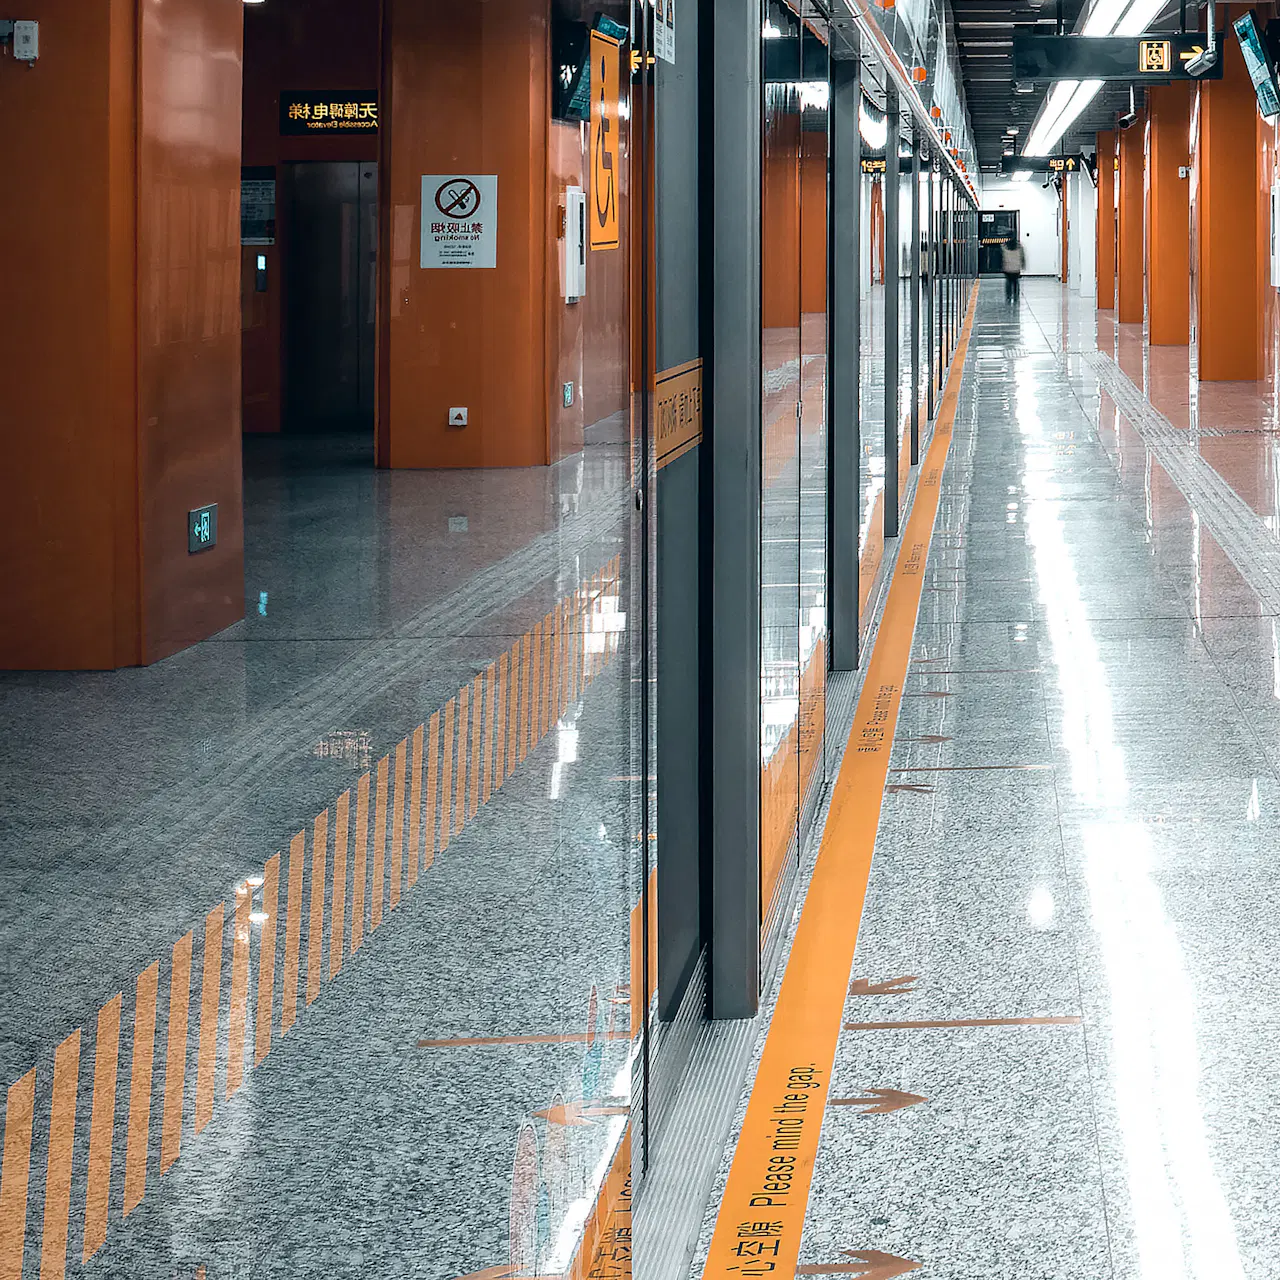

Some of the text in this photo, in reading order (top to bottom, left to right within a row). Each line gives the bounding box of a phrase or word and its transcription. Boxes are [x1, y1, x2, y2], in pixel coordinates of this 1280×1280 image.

[749, 1062, 823, 1207] Please mind the gap.
